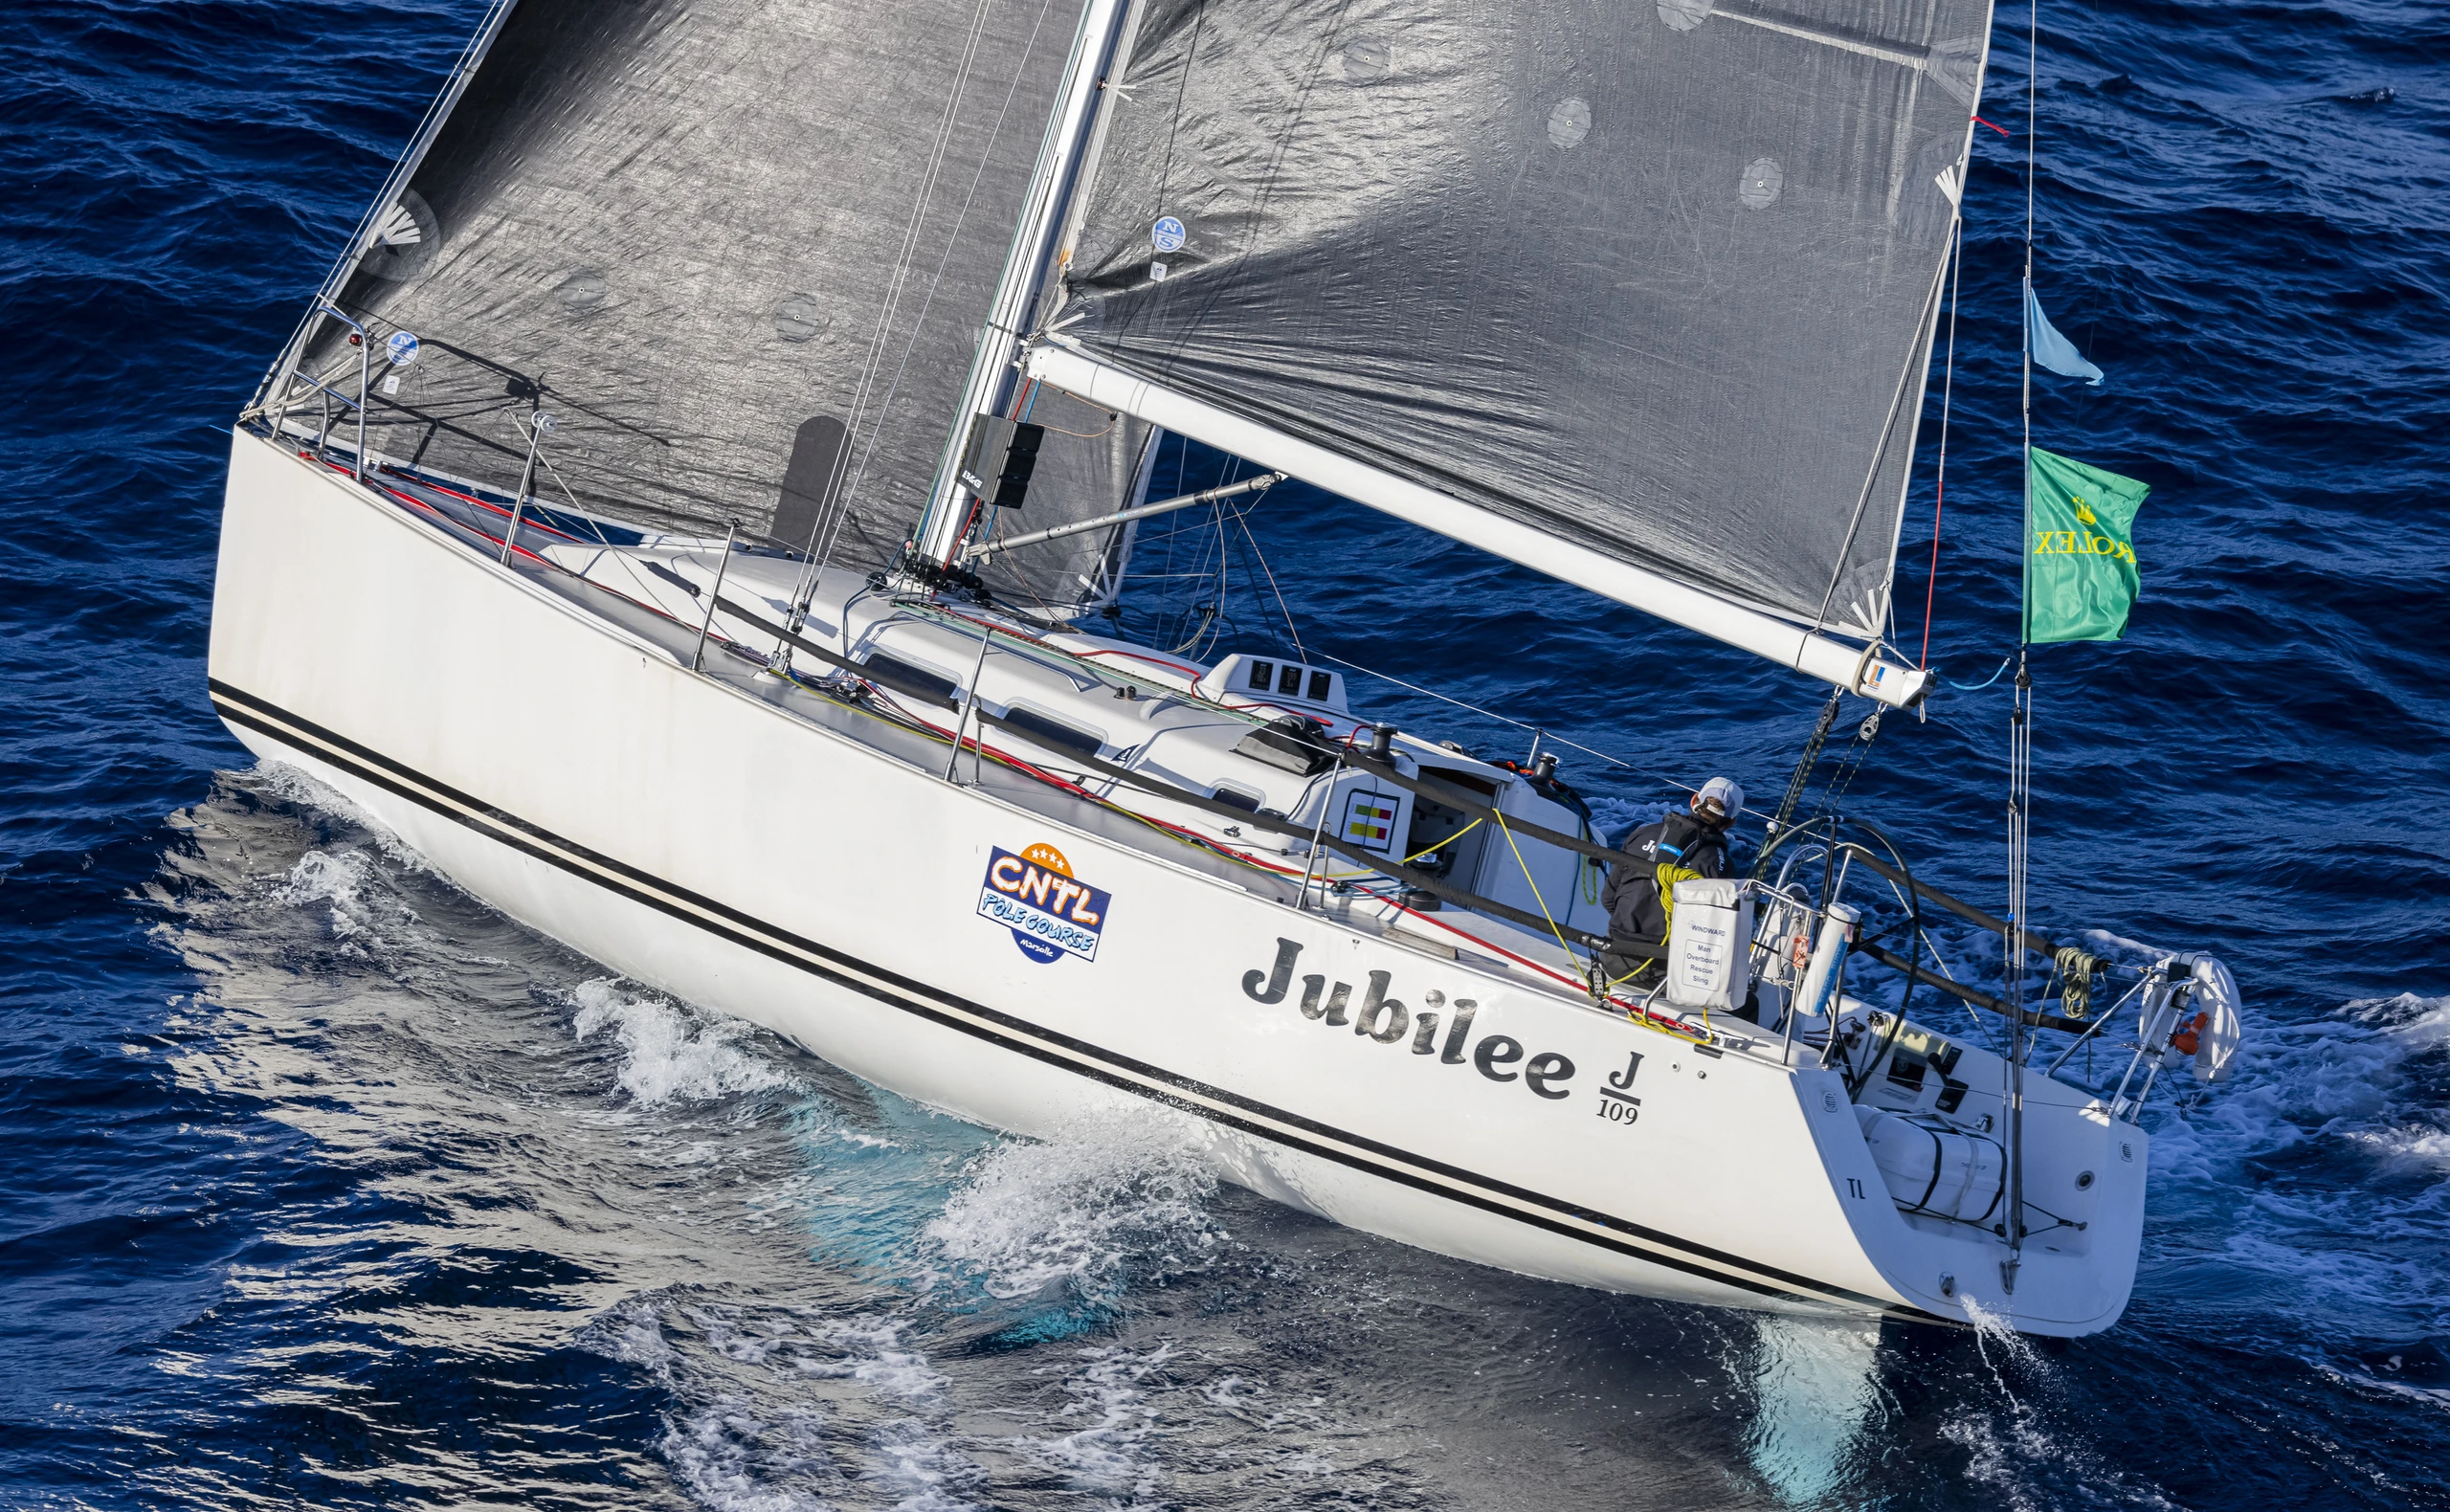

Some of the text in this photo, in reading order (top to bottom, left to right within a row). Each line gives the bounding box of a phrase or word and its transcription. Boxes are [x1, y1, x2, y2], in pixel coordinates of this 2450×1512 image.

[1163, 221, 1179, 233] N
[1160, 236, 1173, 247] S
[962, 470, 983, 489] B&G
[991, 856, 1100, 925] CNTL
[1026, 914, 1094, 951] COURSE
[1691, 924, 1726, 937] WINDWARD
[1698, 945, 1711, 953] Man
[1686, 952, 1720, 966] Overboard
[1690, 964, 1713, 974] Rescue
[1693, 975, 1708, 986] Sling
[1241, 936, 1576, 1101] Jubilee
[1608, 1051, 1645, 1091] J
[1595, 1098, 1639, 1126] 109
[1846, 1177, 1865, 1199] TL
